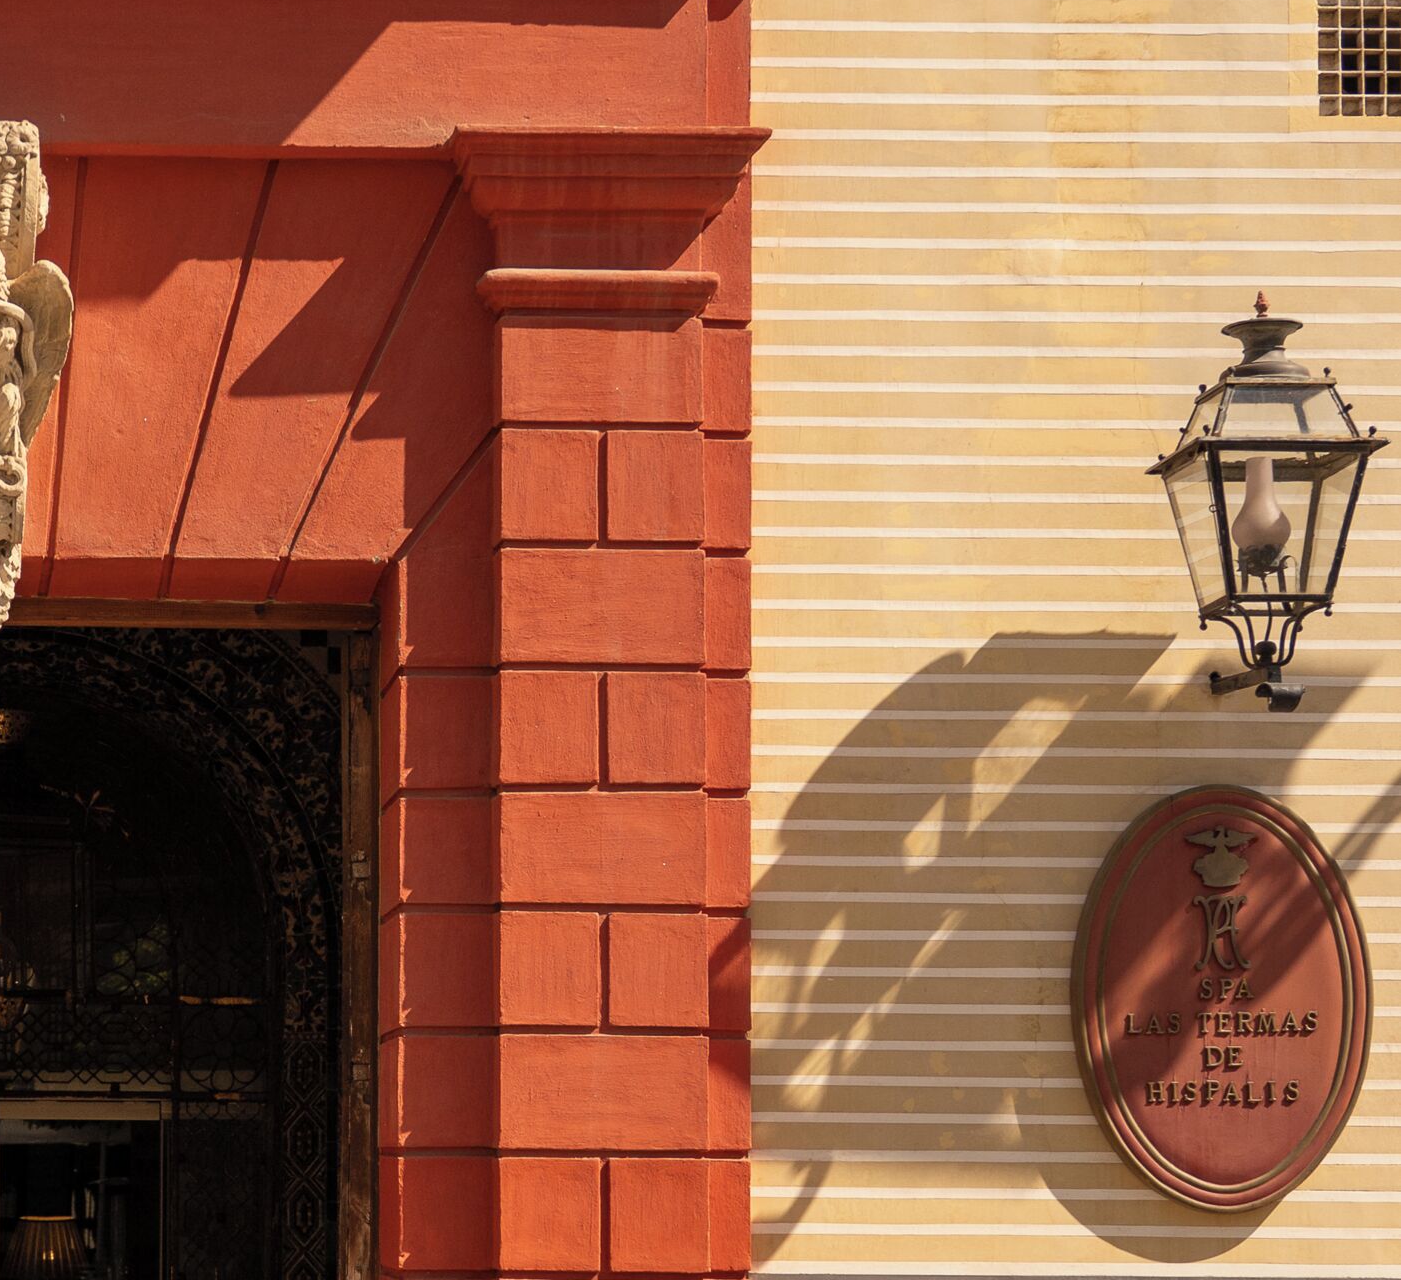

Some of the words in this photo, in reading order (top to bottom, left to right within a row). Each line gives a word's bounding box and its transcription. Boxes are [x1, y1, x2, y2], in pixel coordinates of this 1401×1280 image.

[1199, 977, 1255, 1001] SPA
[1126, 1012, 1183, 1035] LAS
[1196, 1009, 1320, 1035] TERMAS
[1203, 1045, 1245, 1068] DE
[1147, 1079, 1301, 1103] HISPALIS
